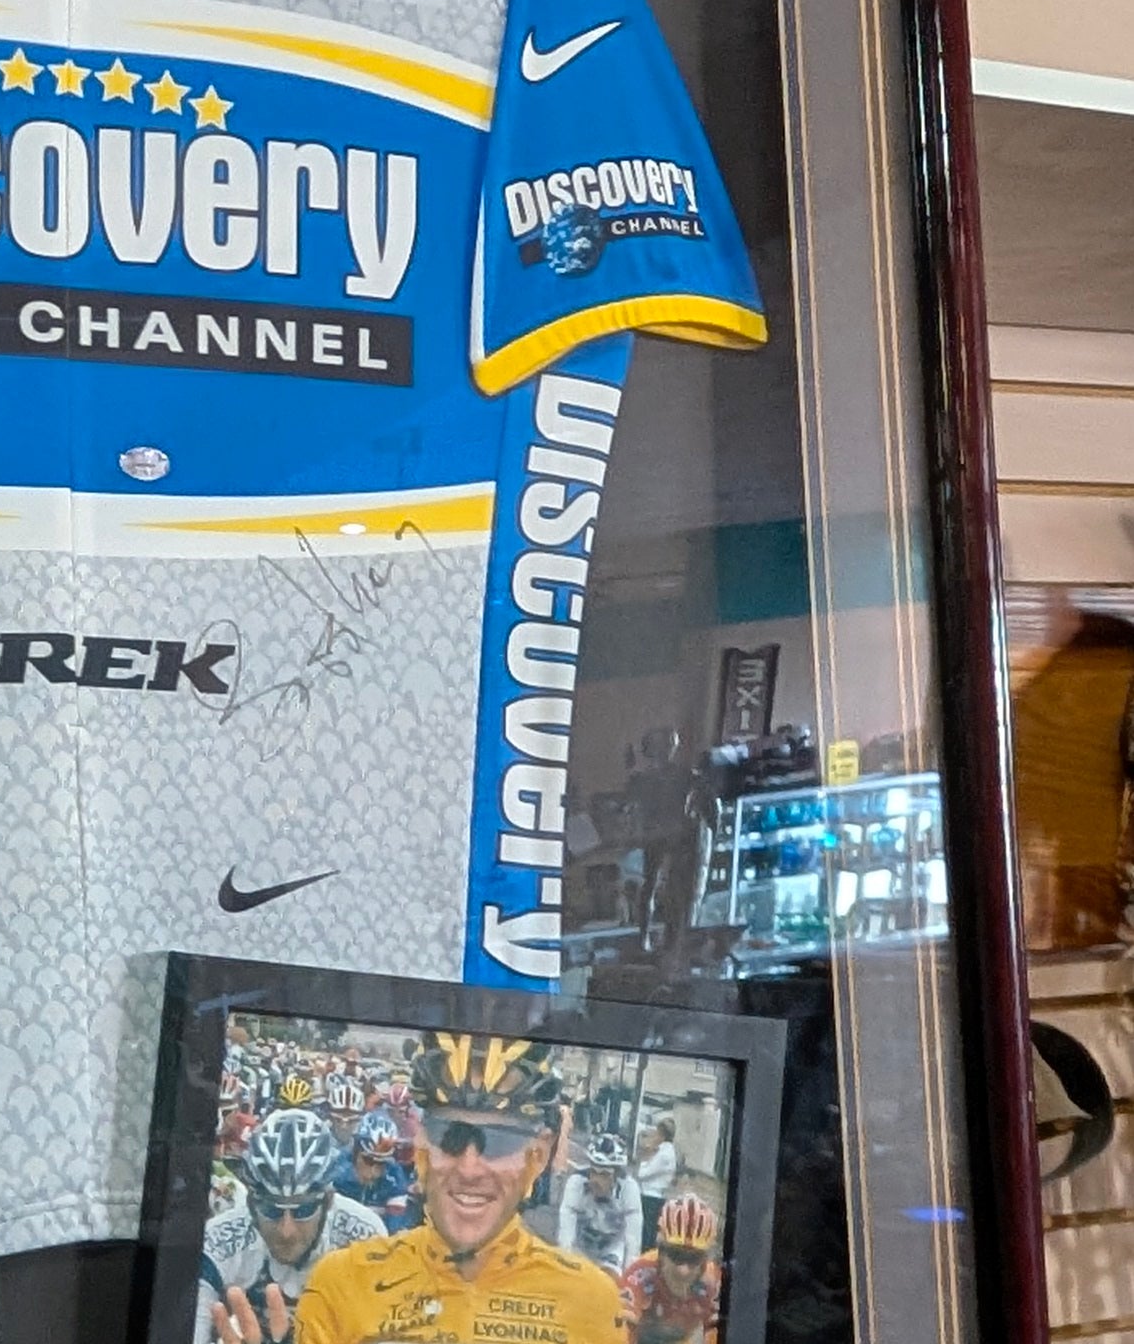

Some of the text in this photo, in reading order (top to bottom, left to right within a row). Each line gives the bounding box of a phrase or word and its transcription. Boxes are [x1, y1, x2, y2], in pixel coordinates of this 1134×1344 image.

[503, 157, 697, 243] Discovery
[609, 215, 706, 238] CHANNEL
[17, 299, 389, 371] CHANNEL
[488, 1297, 558, 1320] CREDIT
